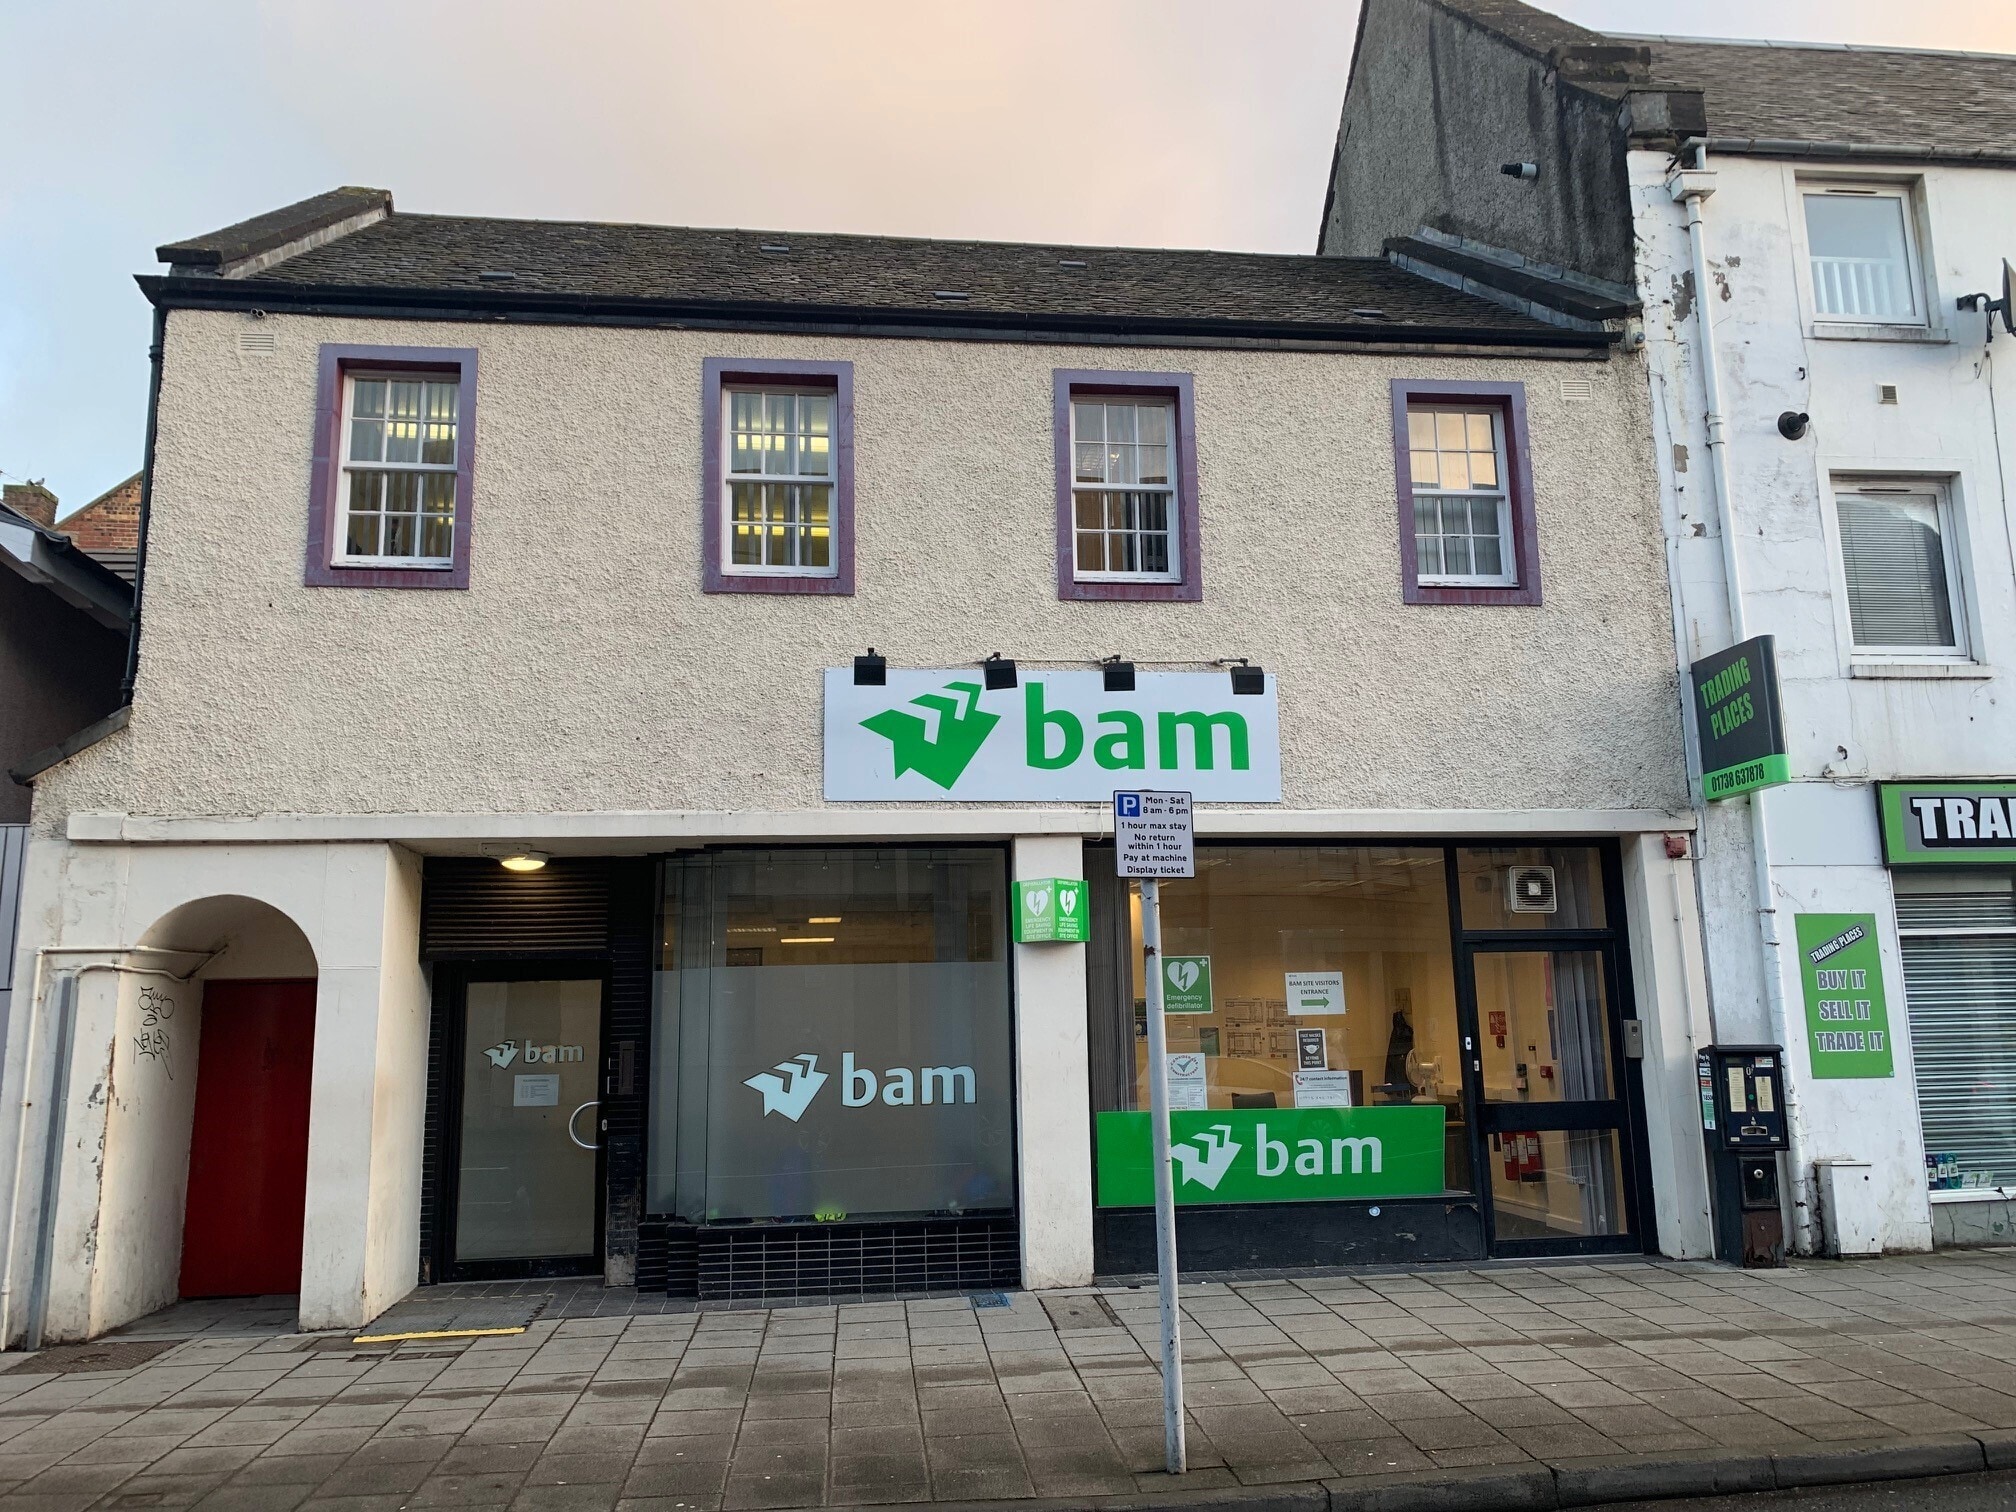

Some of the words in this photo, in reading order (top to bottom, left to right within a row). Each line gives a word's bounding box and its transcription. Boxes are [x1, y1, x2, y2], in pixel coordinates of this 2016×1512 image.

[1700, 656, 1751, 710] TRADING
[1025, 682, 1250, 771] bam
[1710, 692, 1754, 740] PLACES
[1711, 771, 1735, 792] 01738
[1734, 763, 1765, 786] 637878
[1123, 797, 1137, 815] P
[1146, 796, 1163, 804] Mon
[1169, 823, 1187, 831] stay
[1911, 797, 2016, 841] TRA
[1123, 854, 1138, 862] Pay
[1152, 854, 1187, 862] machine
[1127, 866, 1158, 875] Display
[1160, 866, 1185, 874] ticket
[1810, 939, 1840, 963] TRADING
[1838, 926, 1863, 947] PLACES
[1816, 970, 1847, 990] BUY
[1850, 969, 1866, 989] IT
[1167, 994, 1203, 1002] Emergency
[1818, 1000, 1853, 1021] SELL
[1855, 1000, 1871, 1020] IT
[524, 1039, 584, 1064] bam
[1815, 1031, 1865, 1052] TRADE
[1868, 1031, 1884, 1051] IT
[841, 1052, 977, 1108] bam
[1256, 1123, 1383, 1177] bam
